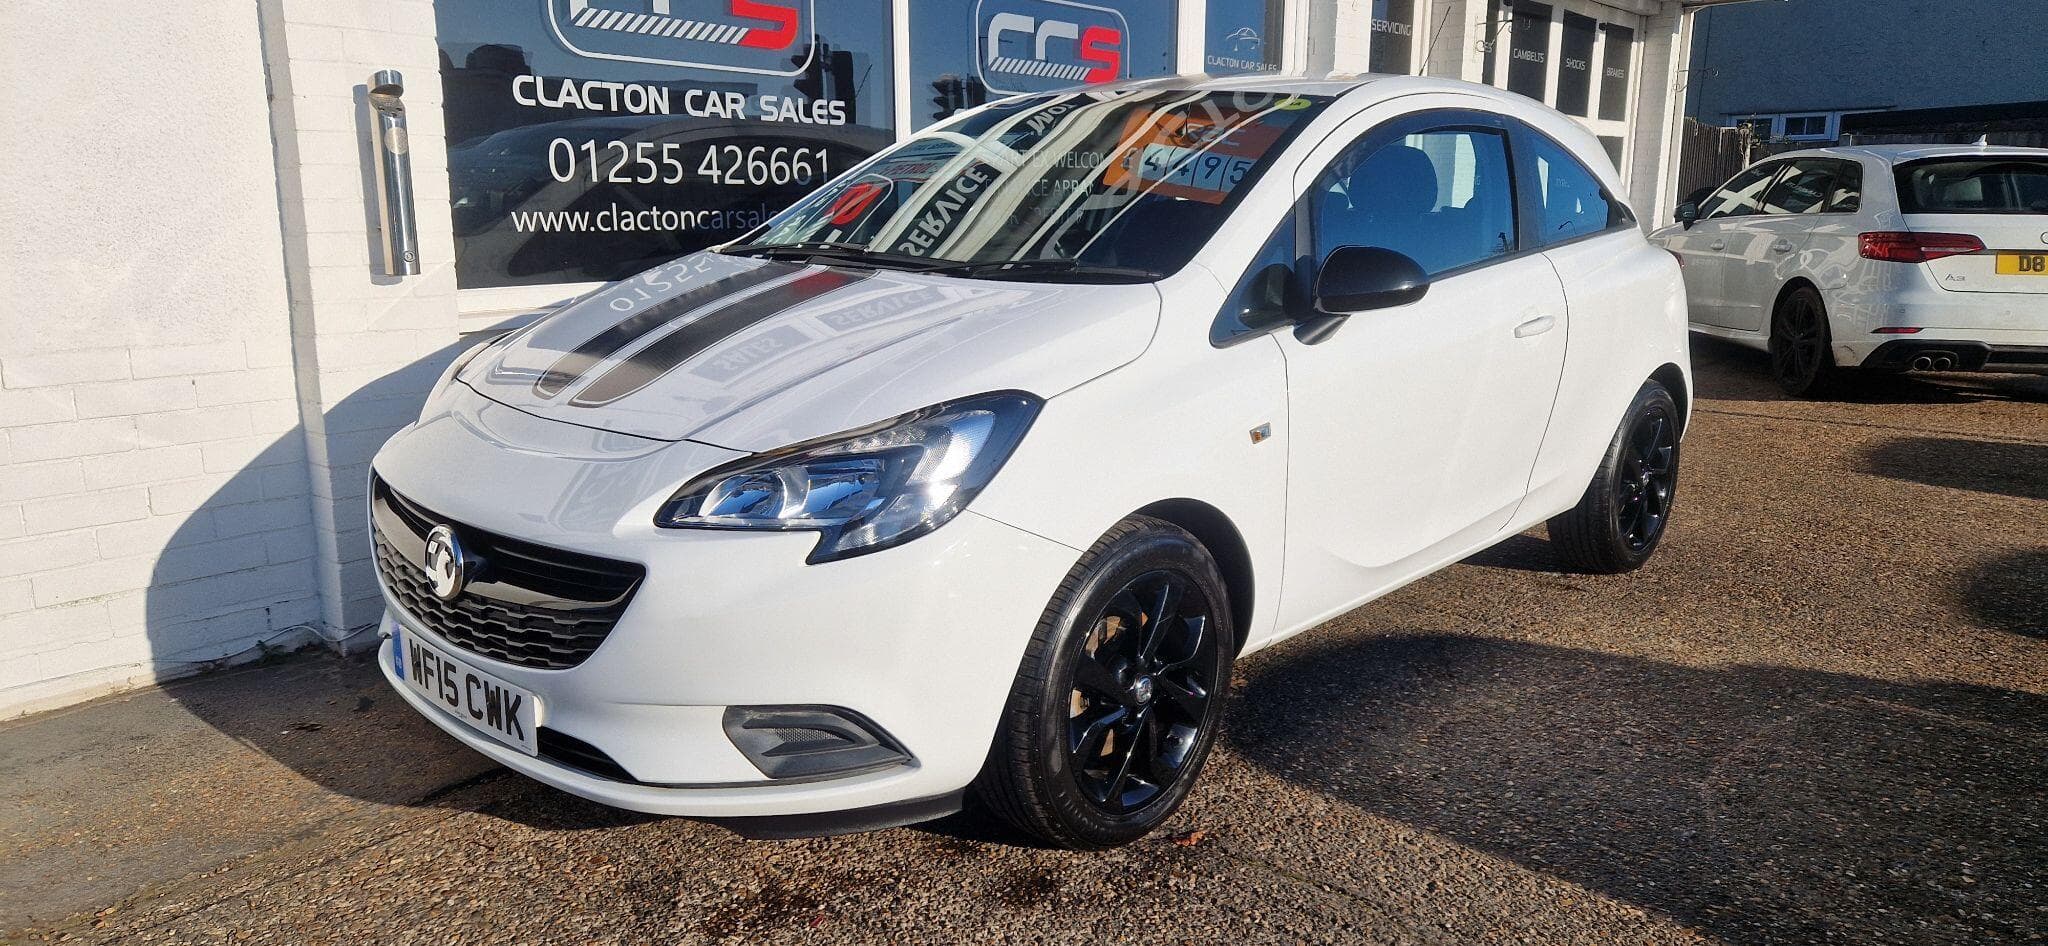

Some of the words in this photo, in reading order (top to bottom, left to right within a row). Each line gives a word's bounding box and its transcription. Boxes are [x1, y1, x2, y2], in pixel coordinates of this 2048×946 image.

[1371, 18, 1412, 37] SERVICING
[1207, 55, 1239, 68] CLACTON
[1241, 60, 1255, 70] CAR
[1513, 48, 1545, 63] CAMBELTS
[1566, 57, 1586, 71] SHOCKS
[1606, 66, 1625, 79] BRAKES
[512, 74, 669, 115] CLACTON
[685, 89, 746, 120] CAR
[759, 95, 846, 126] SALES
[548, 137, 684, 185] 01255
[697, 144, 829, 186] 426661
[2019, 255, 2046, 273] D8
[1945, 273, 1966, 282] A3
[409, 638, 460, 708] WF15
[465, 672, 525, 742] CWK
